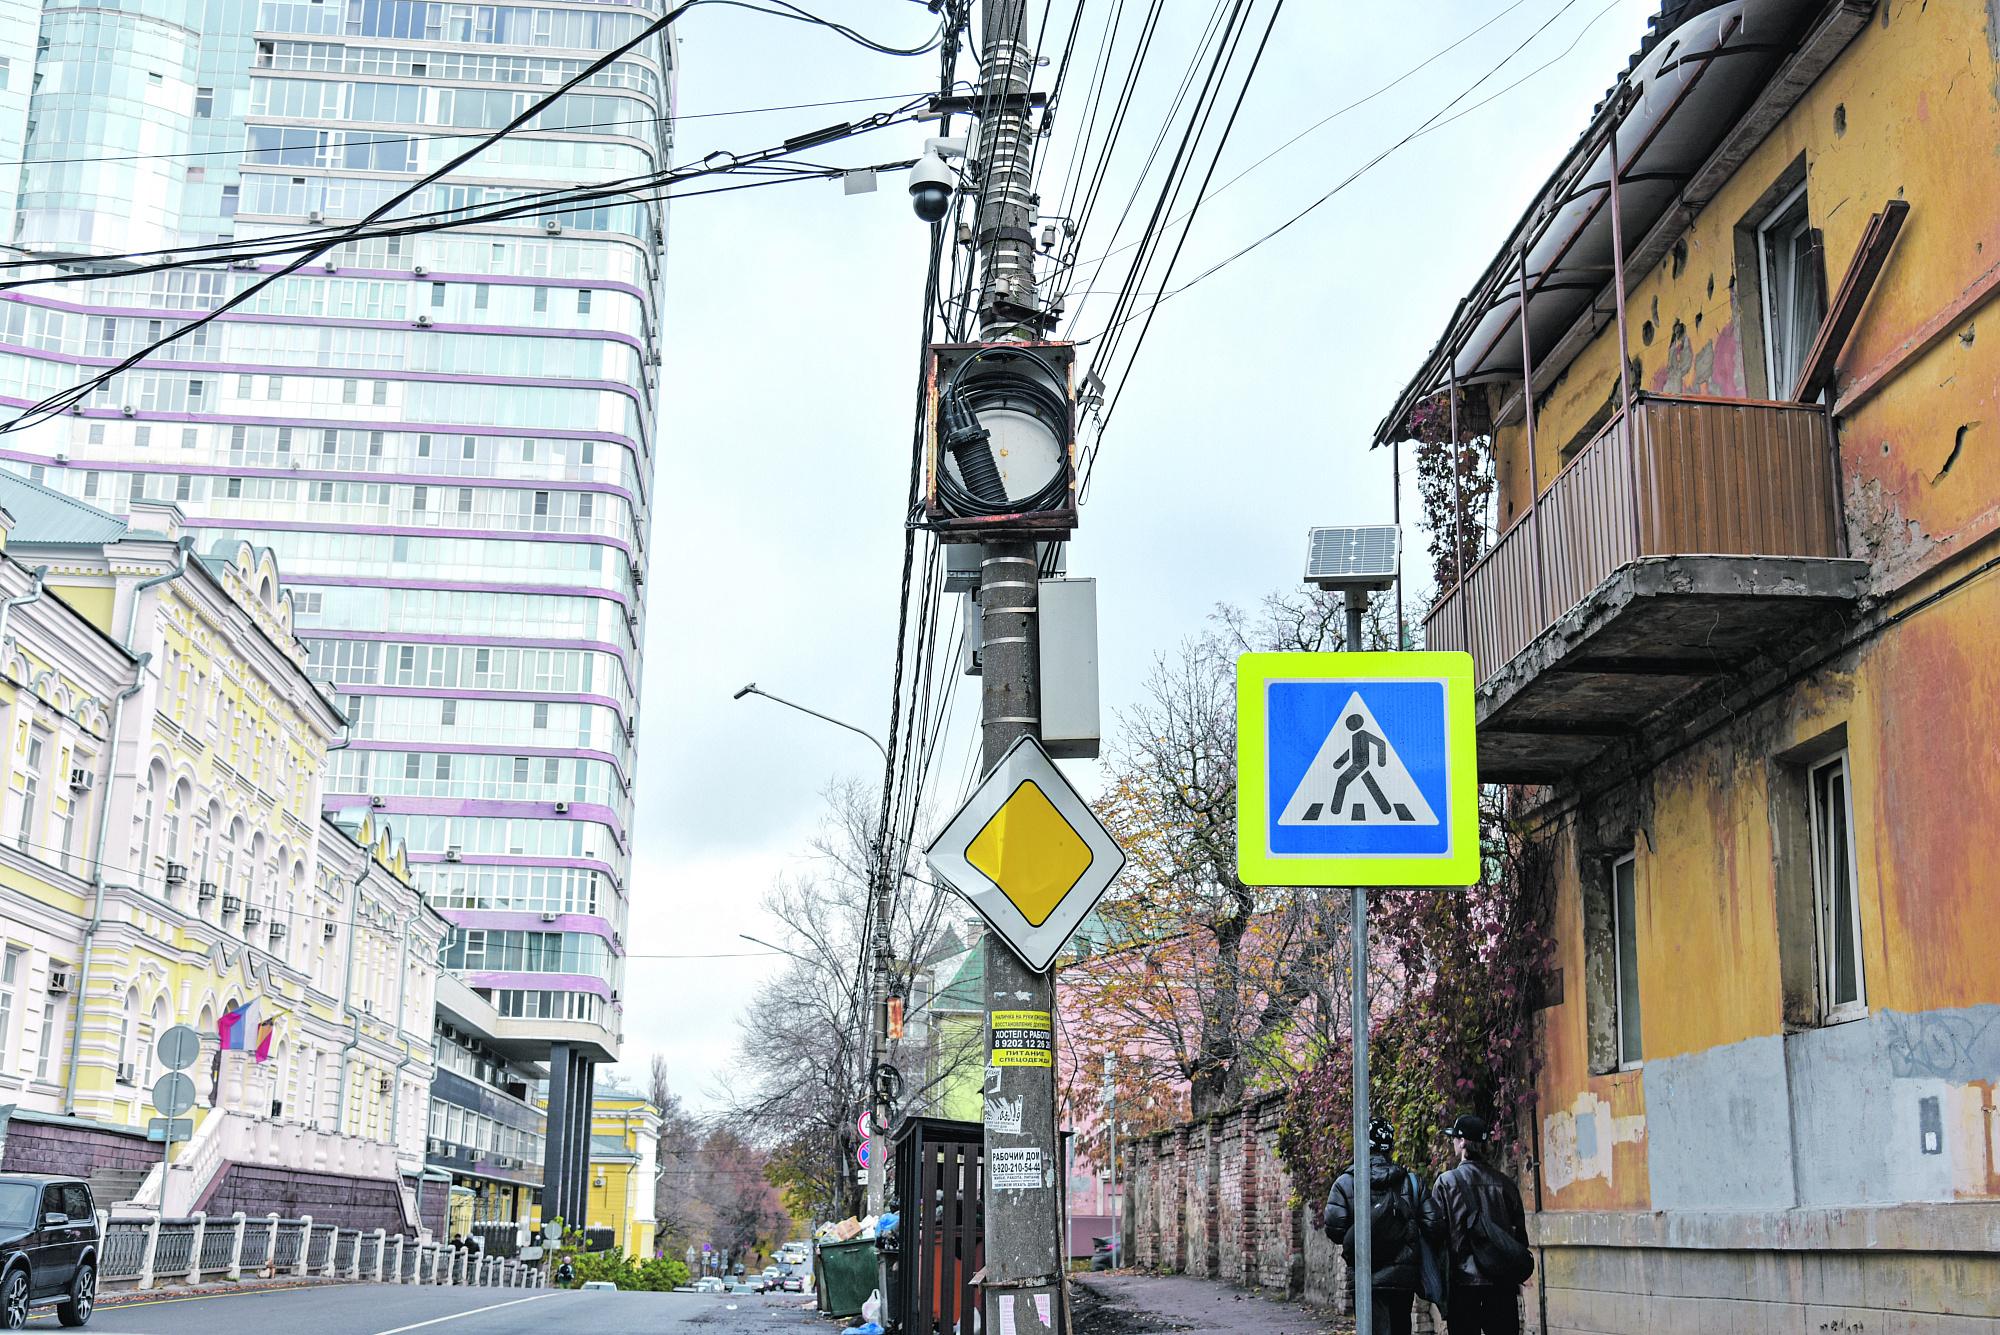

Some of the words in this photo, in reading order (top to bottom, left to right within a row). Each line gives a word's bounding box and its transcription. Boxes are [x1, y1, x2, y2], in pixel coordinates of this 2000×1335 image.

[995, 1030, 1022, 1039] ХОСТЕЛ
[1023, 1030, 1028, 1038] С
[995, 1040, 1000, 1048] 8
[1001, 1039, 1023, 1048] 9202
[1025, 1040, 1035, 1048] 12
